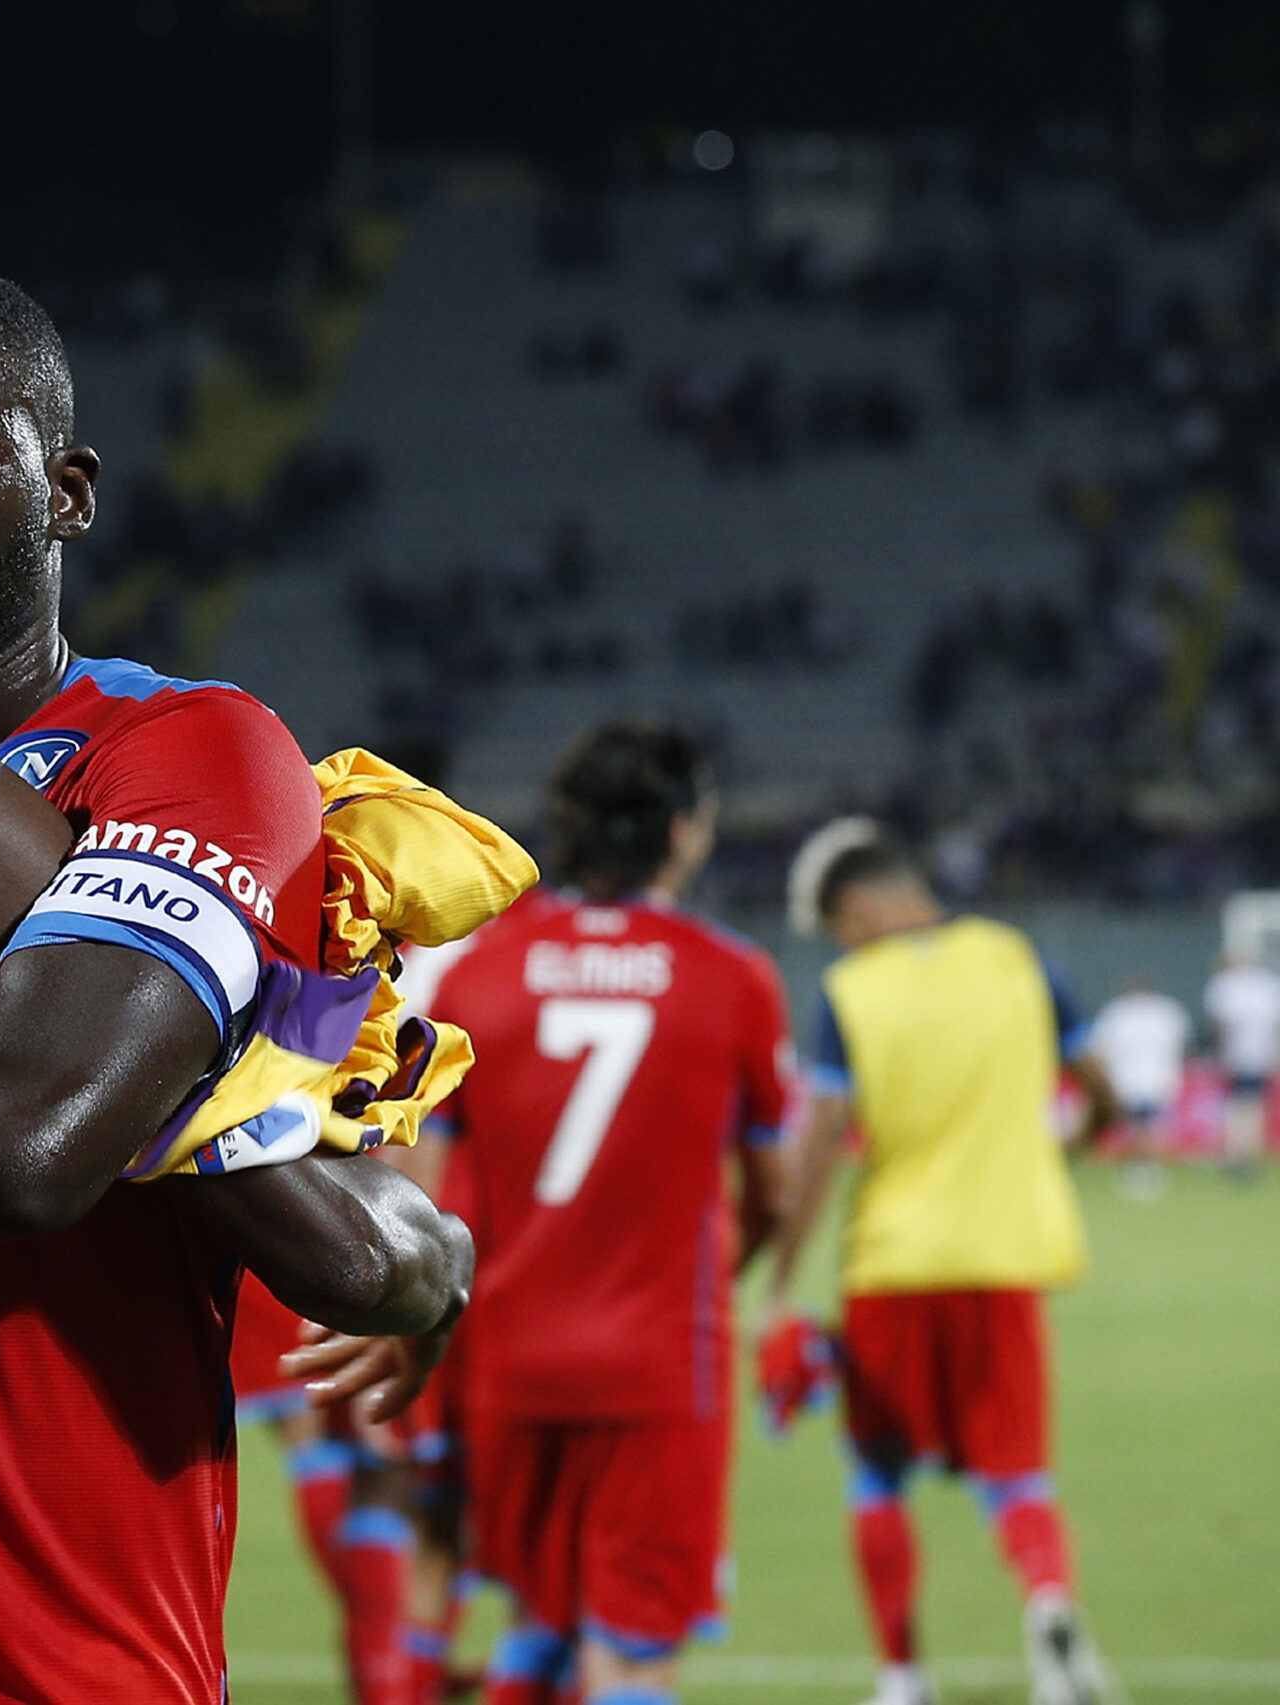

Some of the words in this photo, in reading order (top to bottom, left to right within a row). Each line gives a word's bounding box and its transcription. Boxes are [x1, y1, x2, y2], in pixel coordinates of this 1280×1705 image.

[19, 749, 69, 780] N
[48, 872, 200, 922] ITANO
[74, 819, 274, 927] amazon
[535, 1000, 656, 1207] 7
